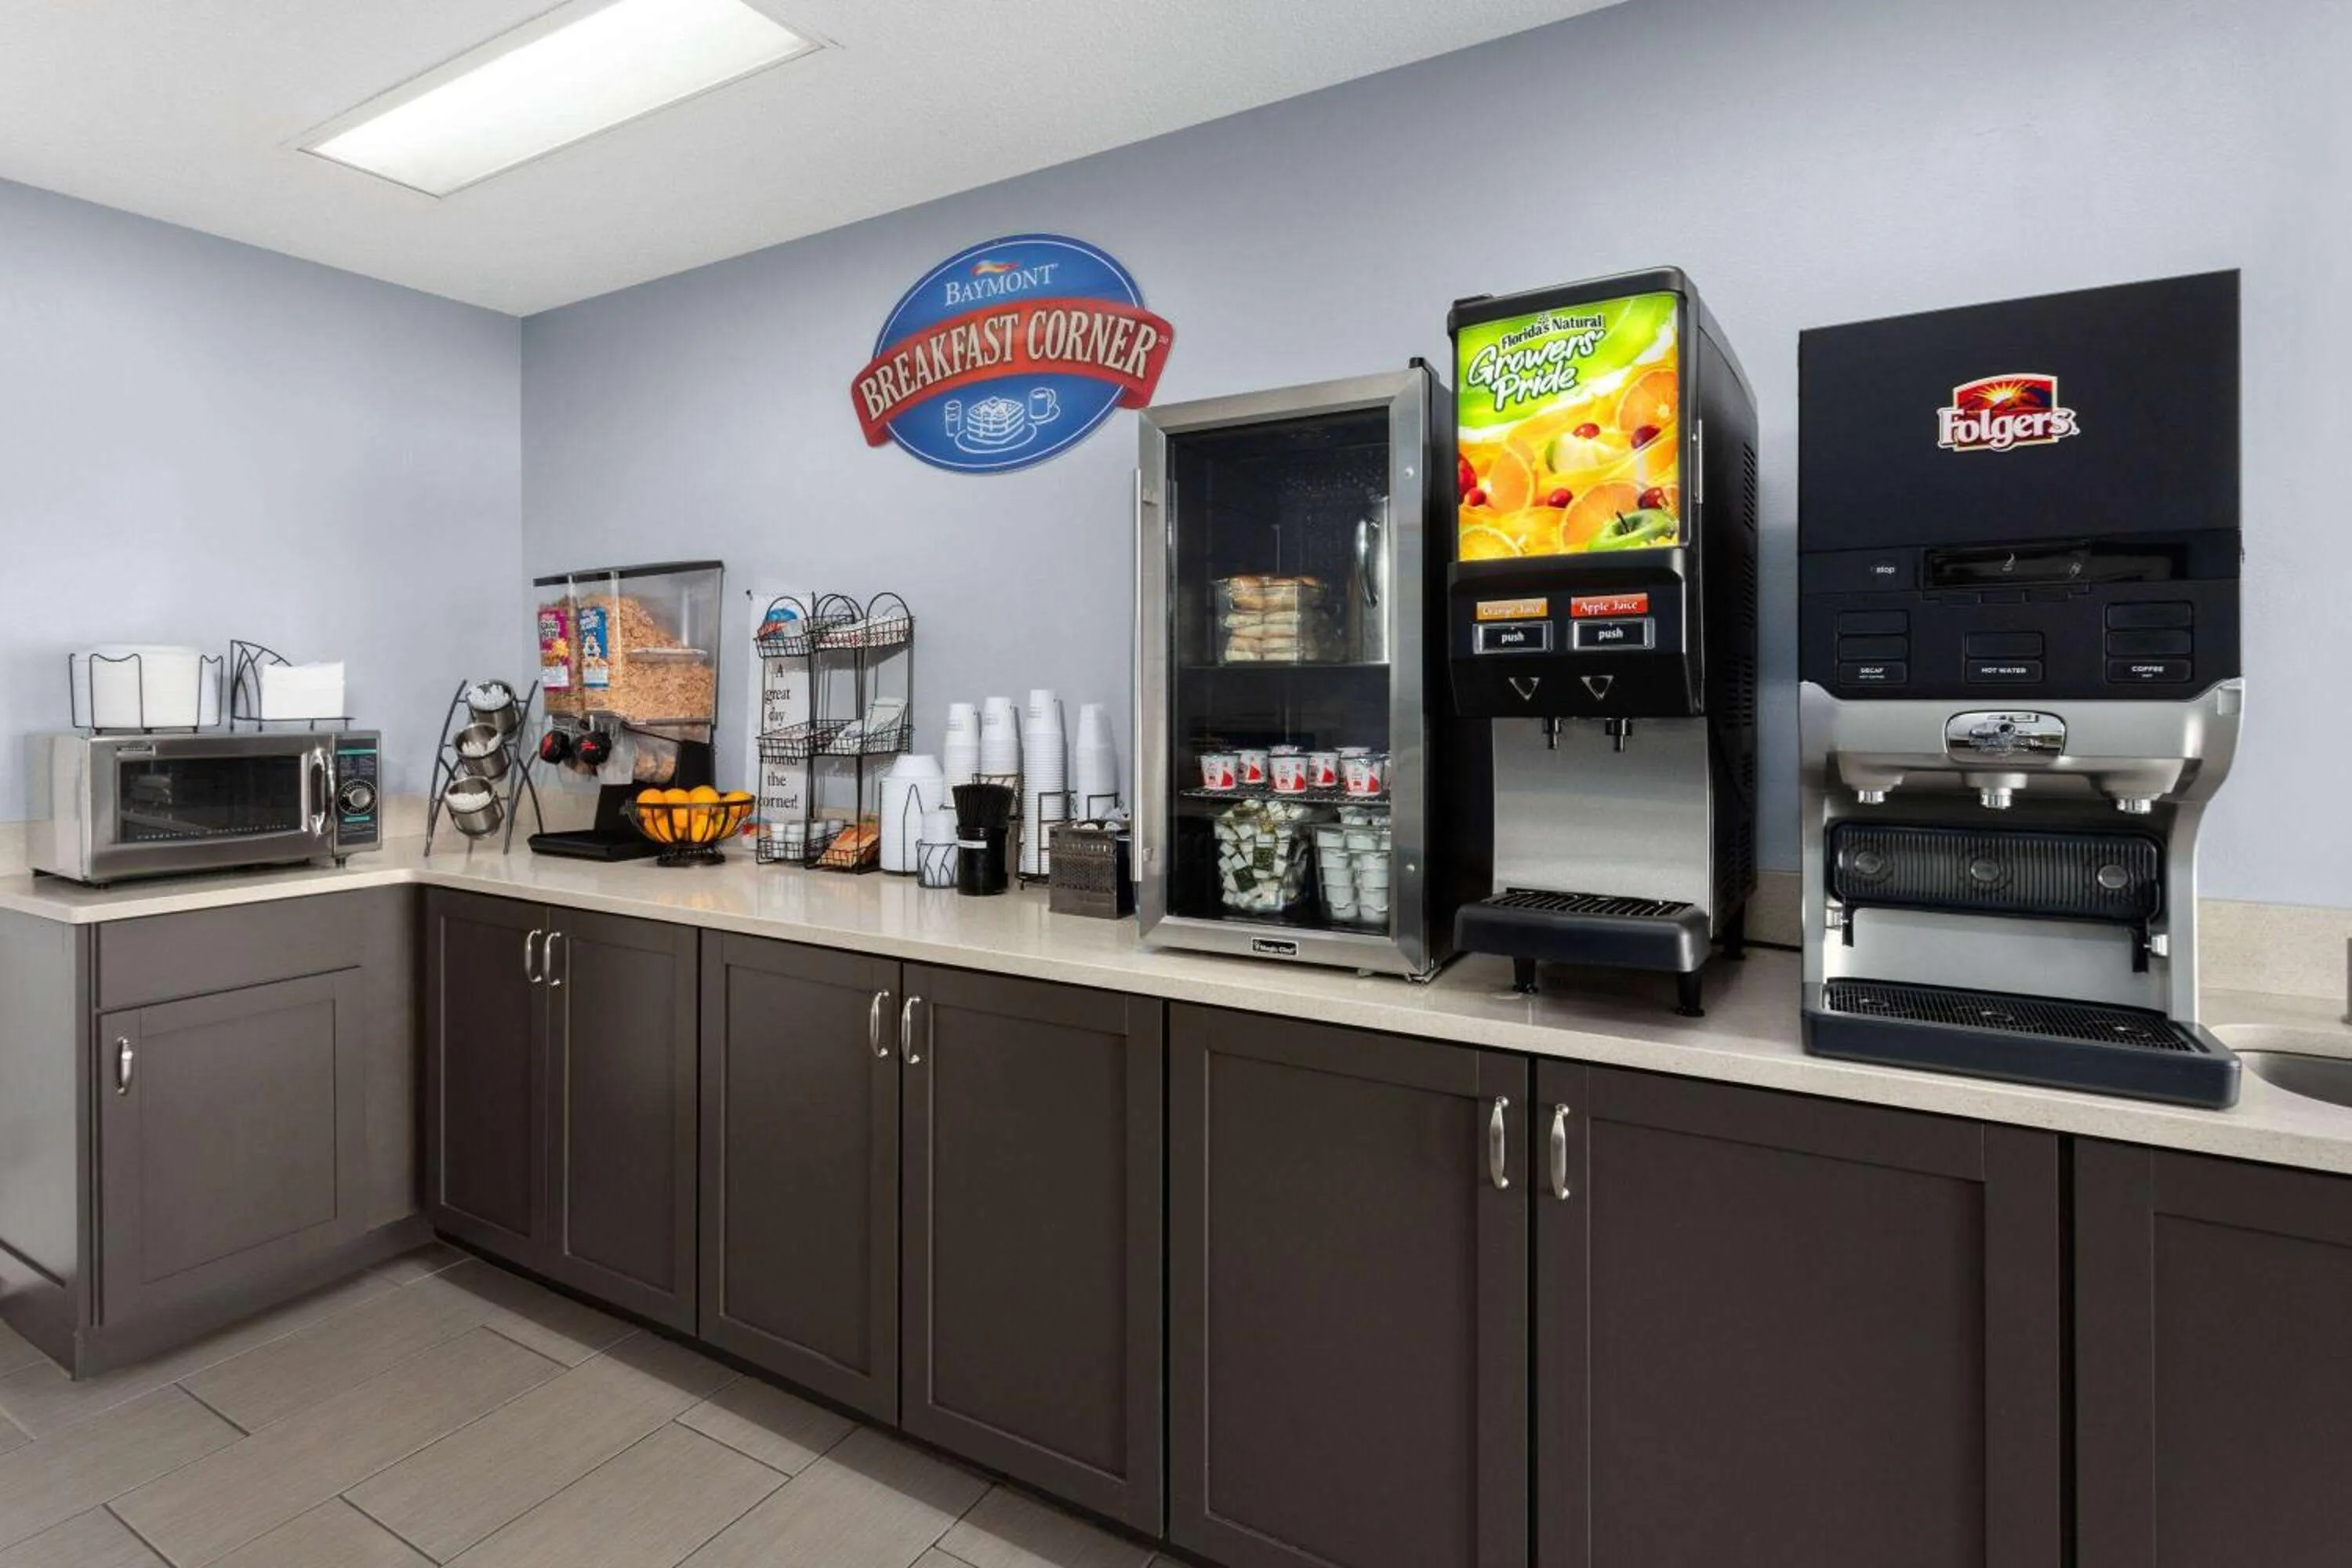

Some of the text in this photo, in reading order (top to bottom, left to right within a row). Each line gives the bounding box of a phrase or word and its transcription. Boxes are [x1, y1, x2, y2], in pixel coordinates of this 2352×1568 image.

[945, 264, 1055, 307] BAYMONT
[1501, 314, 1602, 350] Florida's Natural
[860, 310, 1157, 421] BREAKFAST CORNER
[1490, 360, 1577, 411] Pride
[1939, 408, 2074, 448] Folgers
[1579, 599, 1639, 615] Apple Juice
[1501, 630, 1525, 644] push
[1599, 626, 1624, 641] push
[775, 662, 785, 678] A
[764, 689, 791, 705] great
[768, 706, 785, 727] day
[768, 771, 786, 786] the
